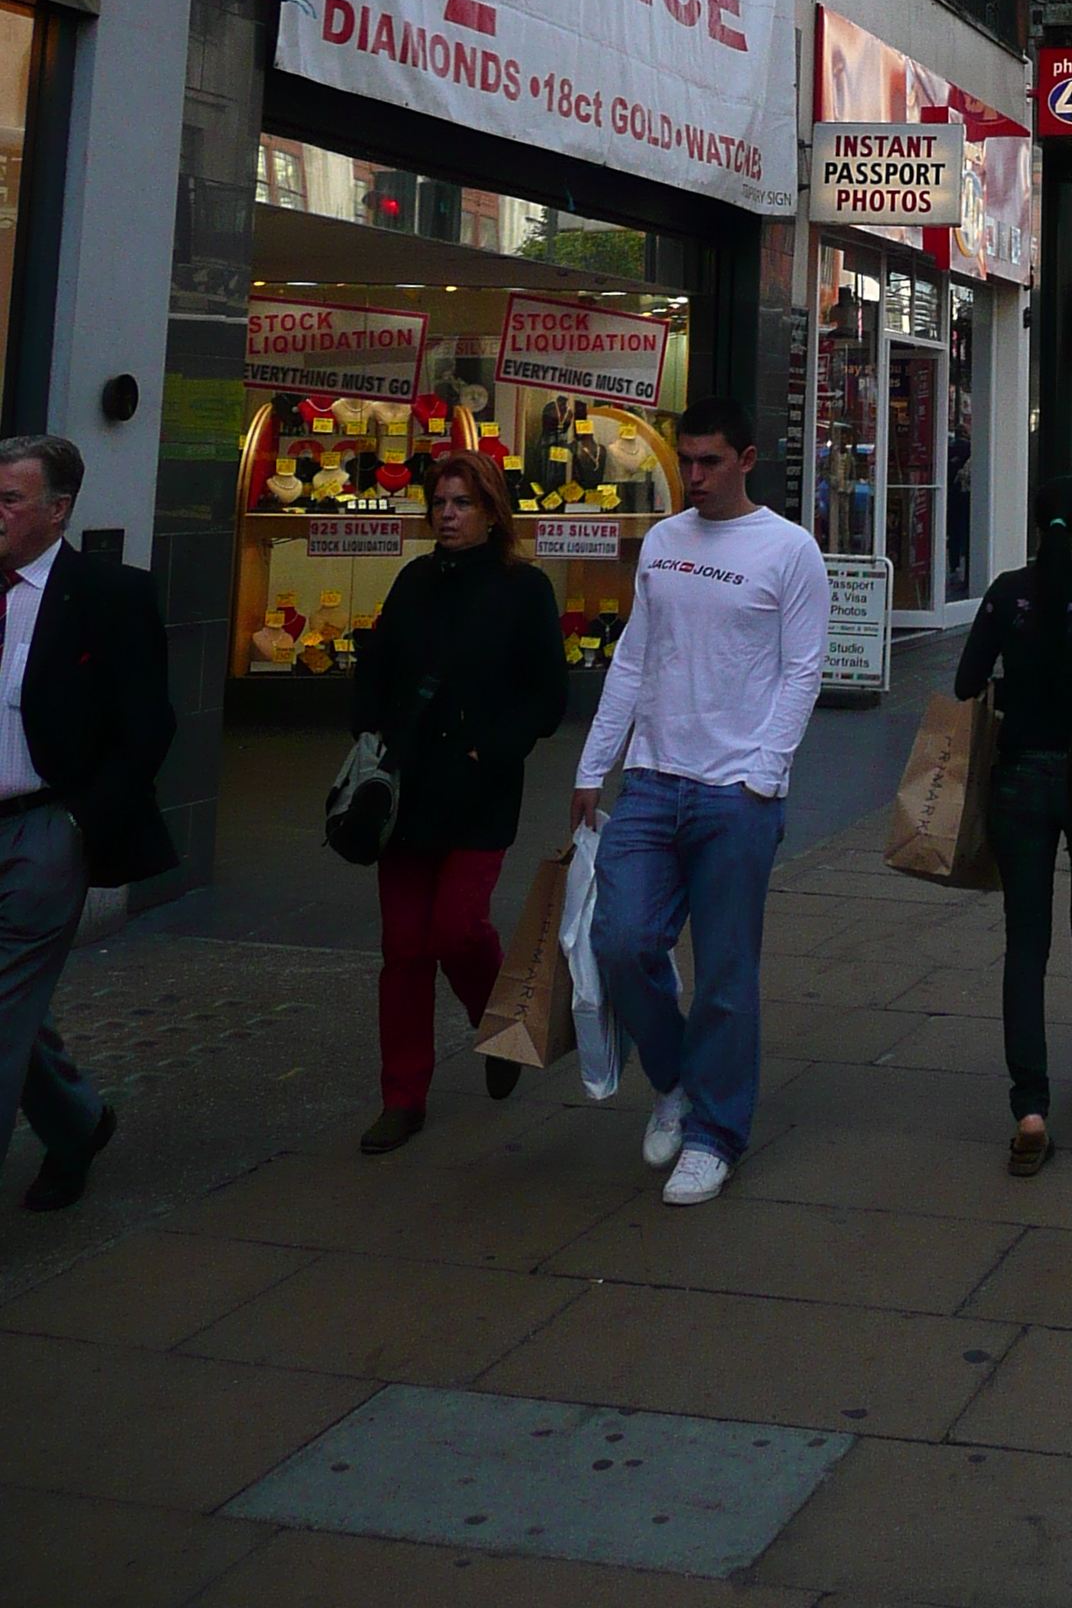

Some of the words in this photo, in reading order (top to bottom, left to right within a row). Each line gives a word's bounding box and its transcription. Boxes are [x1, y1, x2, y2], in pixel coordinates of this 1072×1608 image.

[834, 135, 938, 159] INSTANT
[824, 162, 946, 186] PASSPORT
[767, 190, 792, 207] SIGN
[836, 189, 932, 213] PHOTOS
[250, 311, 333, 334] STOCK
[512, 313, 590, 331] STOCK
[248, 328, 412, 355] LIQUIDATION
[511, 333, 658, 352] LIQUIDATION
[244, 363, 339, 388] EVERYTHING
[341, 373, 387, 393] MUST
[388, 378, 411, 396] GO
[503, 359, 592, 388] EVERYTHING
[595, 373, 634, 394] MUST
[635, 381, 655, 399] GO
[310, 523, 338, 536] 925
[344, 523, 400, 536] SILVER
[538, 523, 564, 537] 925
[569, 524, 618, 538] SILVER
[310, 540, 339, 553] STOCK
[343, 540, 399, 553] LIQUIDATION
[538, 541, 565, 554] STOCK
[567, 541, 617, 555] LIQUIDATION
[648, 558, 681, 571] JACK
[693, 565, 745, 585] JONES
[828, 578, 875, 592] Passport
[831, 592, 839, 602] &
[844, 593, 868, 603] Visa
[830, 604, 868, 617] Photos
[829, 641, 865, 654] Studio
[824, 655, 870, 669] Portraits
